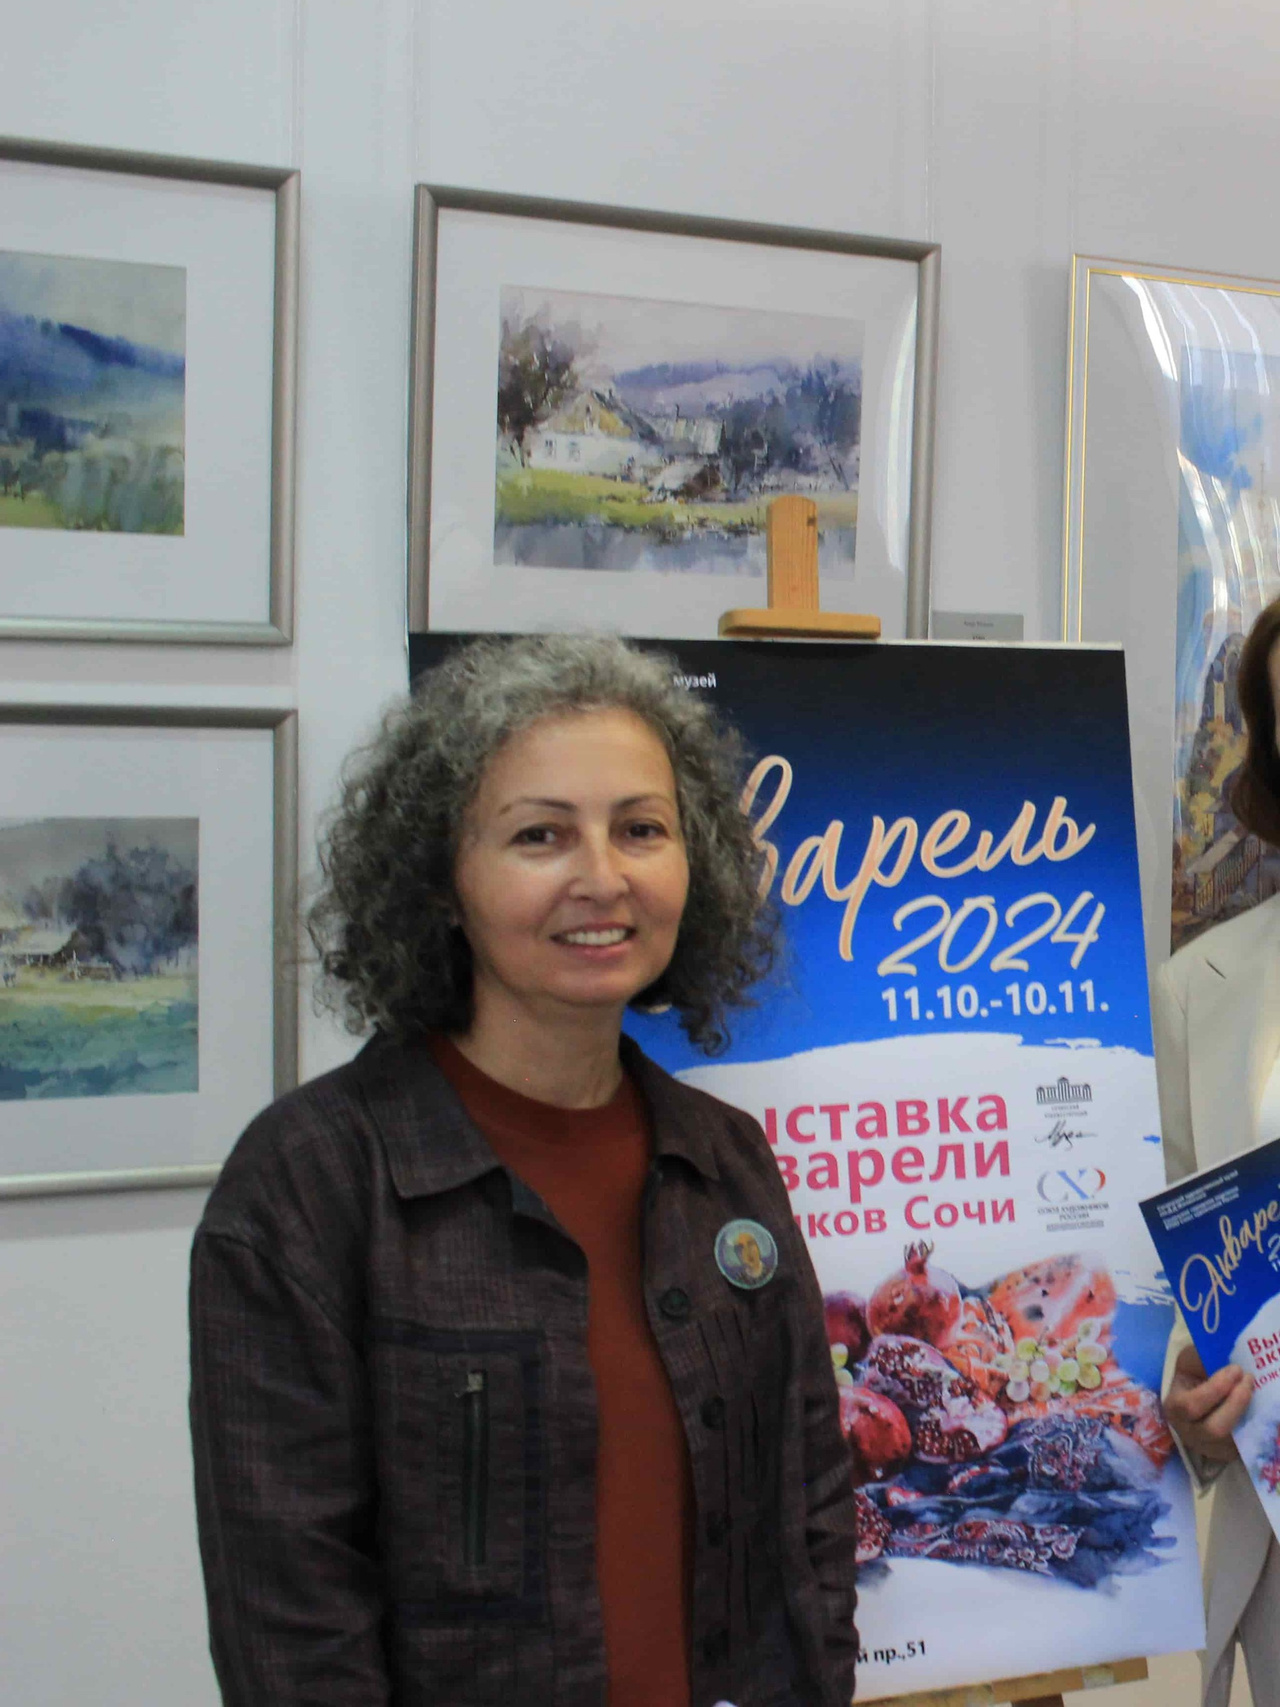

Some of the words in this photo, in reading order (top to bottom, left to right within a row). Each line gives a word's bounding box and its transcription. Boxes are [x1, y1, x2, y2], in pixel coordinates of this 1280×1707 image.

[673, 670, 717, 688] музей
[877, 890, 1106, 977] 2024
[882, 979, 1109, 1021] 11.10.-10.11.
[793, 1207, 888, 1239] ков
[904, 1195, 1016, 1231] Сочи
